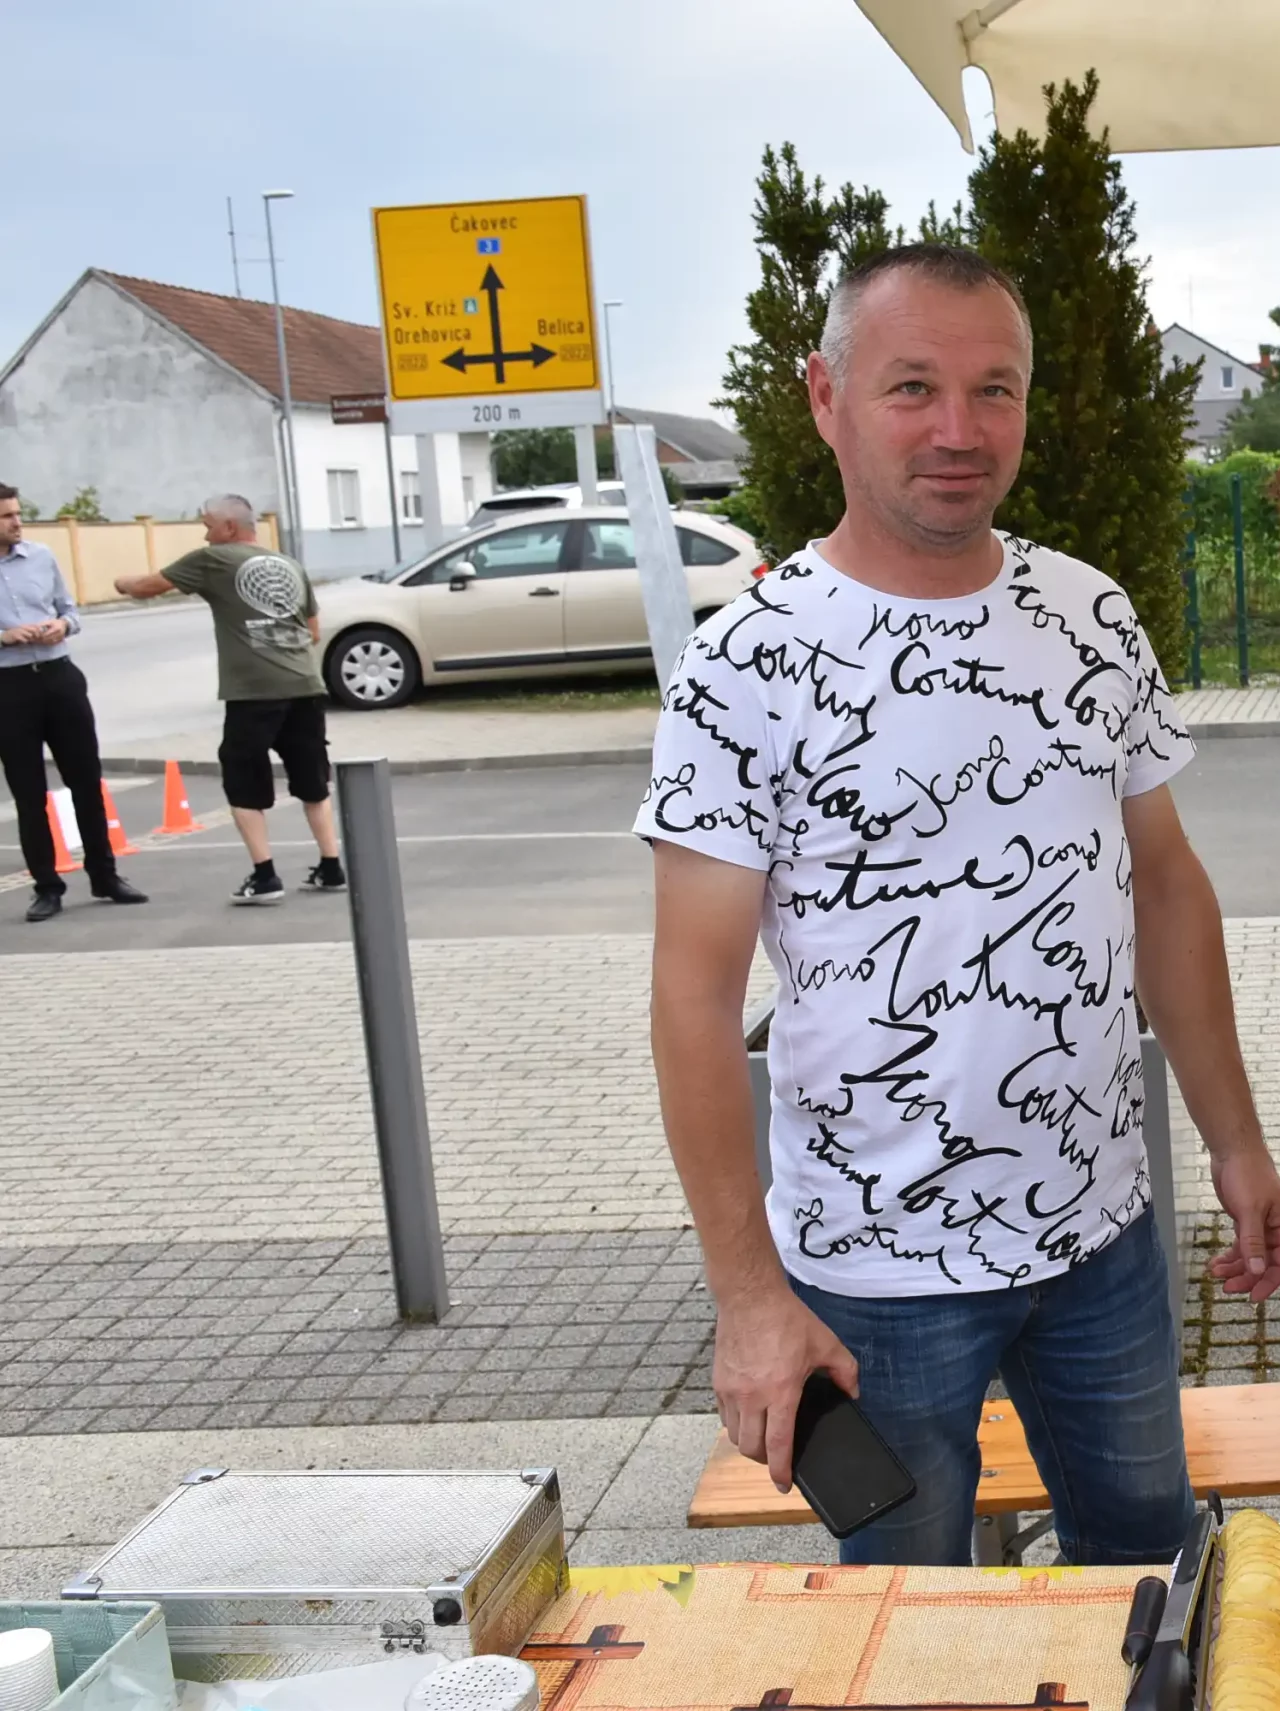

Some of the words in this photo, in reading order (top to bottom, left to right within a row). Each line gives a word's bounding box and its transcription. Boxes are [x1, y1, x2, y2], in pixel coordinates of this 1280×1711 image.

[449, 211, 518, 234] Čakovec
[484, 238, 493, 253] 3
[392, 302, 419, 321] Sv.
[394, 327, 472, 345] Orehovica
[537, 318, 585, 337] Belica
[472, 405, 502, 423] 200
[508, 407, 521, 420] m
